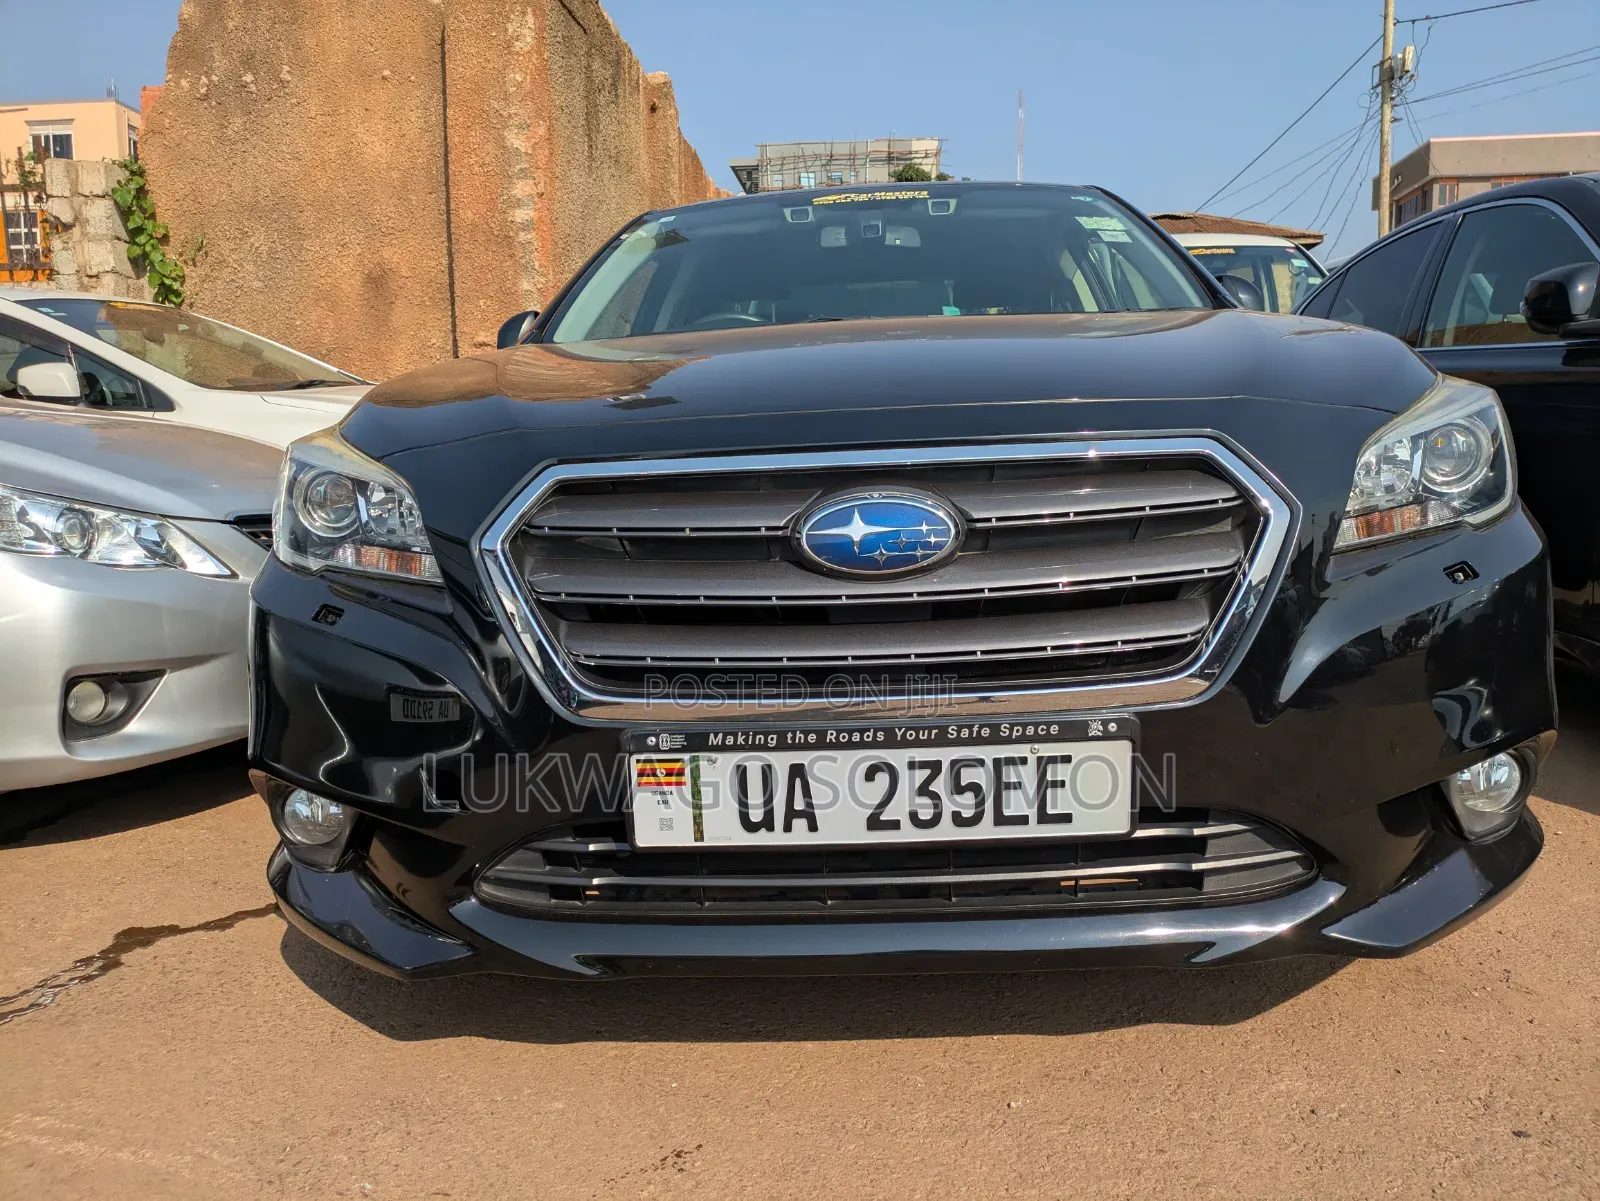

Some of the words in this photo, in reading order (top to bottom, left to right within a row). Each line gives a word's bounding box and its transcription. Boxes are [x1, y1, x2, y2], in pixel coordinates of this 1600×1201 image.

[708, 731, 777, 747] Making
[786, 730, 817, 744] the
[826, 729, 885, 743] Roads
[894, 727, 938, 741] Your
[947, 724, 990, 739] Safe
[999, 723, 1059, 739] Space
[735, 762, 819, 834] UA
[864, 754, 1073, 831] 235EE
